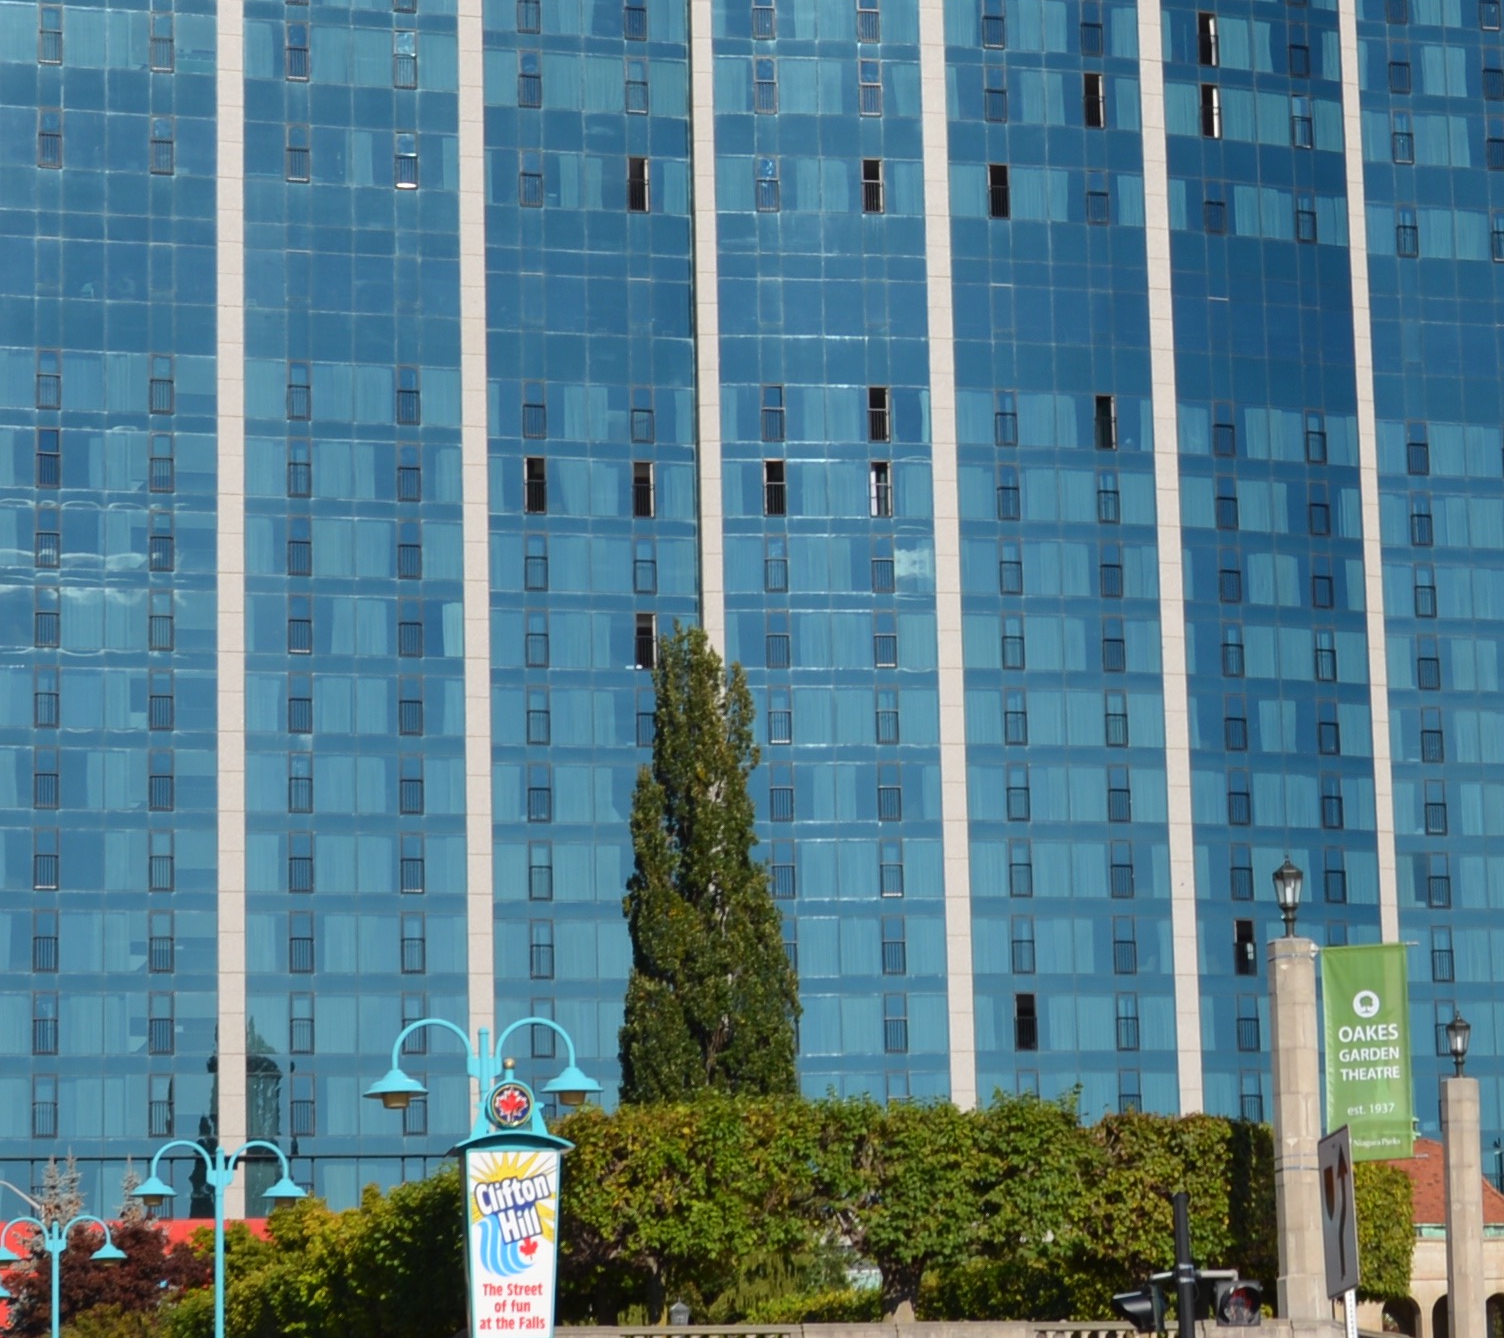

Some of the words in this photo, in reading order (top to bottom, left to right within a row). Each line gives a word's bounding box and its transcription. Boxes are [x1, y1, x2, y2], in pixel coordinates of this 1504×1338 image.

[1338, 1023, 1400, 1043] OAKES
[1339, 1046, 1400, 1063] GARDEN
[1340, 1065, 1401, 1082] THEATRE
[1347, 1104, 1367, 1117] est.
[1369, 1102, 1395, 1115] 1937
[474, 1173, 552, 1217] Clifton
[497, 1204, 543, 1246] Hill
[482, 1284, 503, 1296] The
[507, 1283, 543, 1296] Street
[494, 1300, 507, 1313] of
[511, 1300, 531, 1312] fun
[479, 1317, 492, 1330] at
[495, 1317, 516, 1330] the
[518, 1316, 546, 1330] Falls
